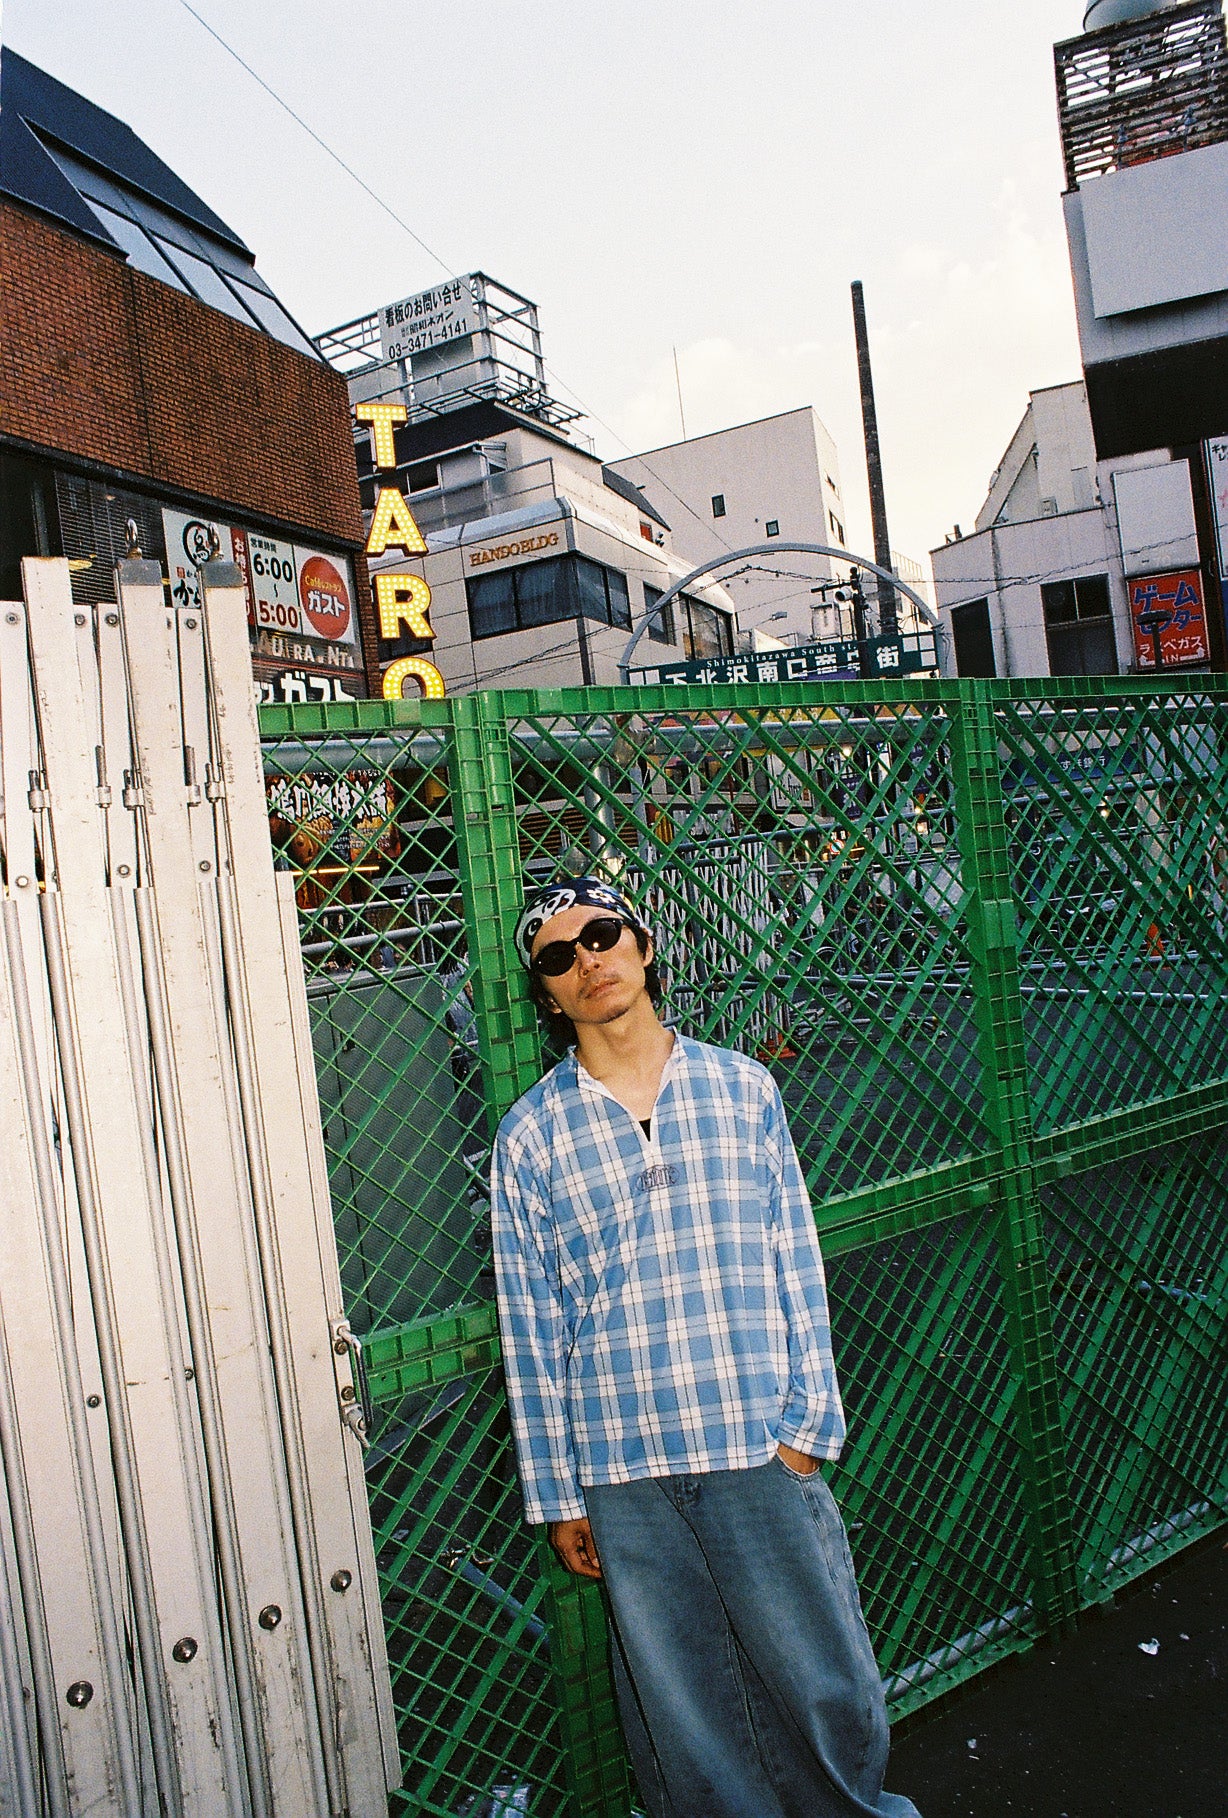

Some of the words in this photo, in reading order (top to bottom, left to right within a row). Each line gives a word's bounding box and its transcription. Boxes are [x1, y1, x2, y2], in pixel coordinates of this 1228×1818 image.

[385, 281, 461, 327] 看板のお問い合せ
[388, 318, 467, 359] 03-3471-4141
[355, 403, 446, 699] TARO
[254, 553, 294, 583] 6:00
[307, 590, 346, 618] ガスト
[1134, 580, 1200, 613] ゲーム
[259, 600, 299, 629] 5:00
[706, 650, 795, 668] Shimokitazawa
[801, 644, 836, 656] South
[841, 643, 858, 651] st.
[1140, 636, 1203, 655] ラベガス
